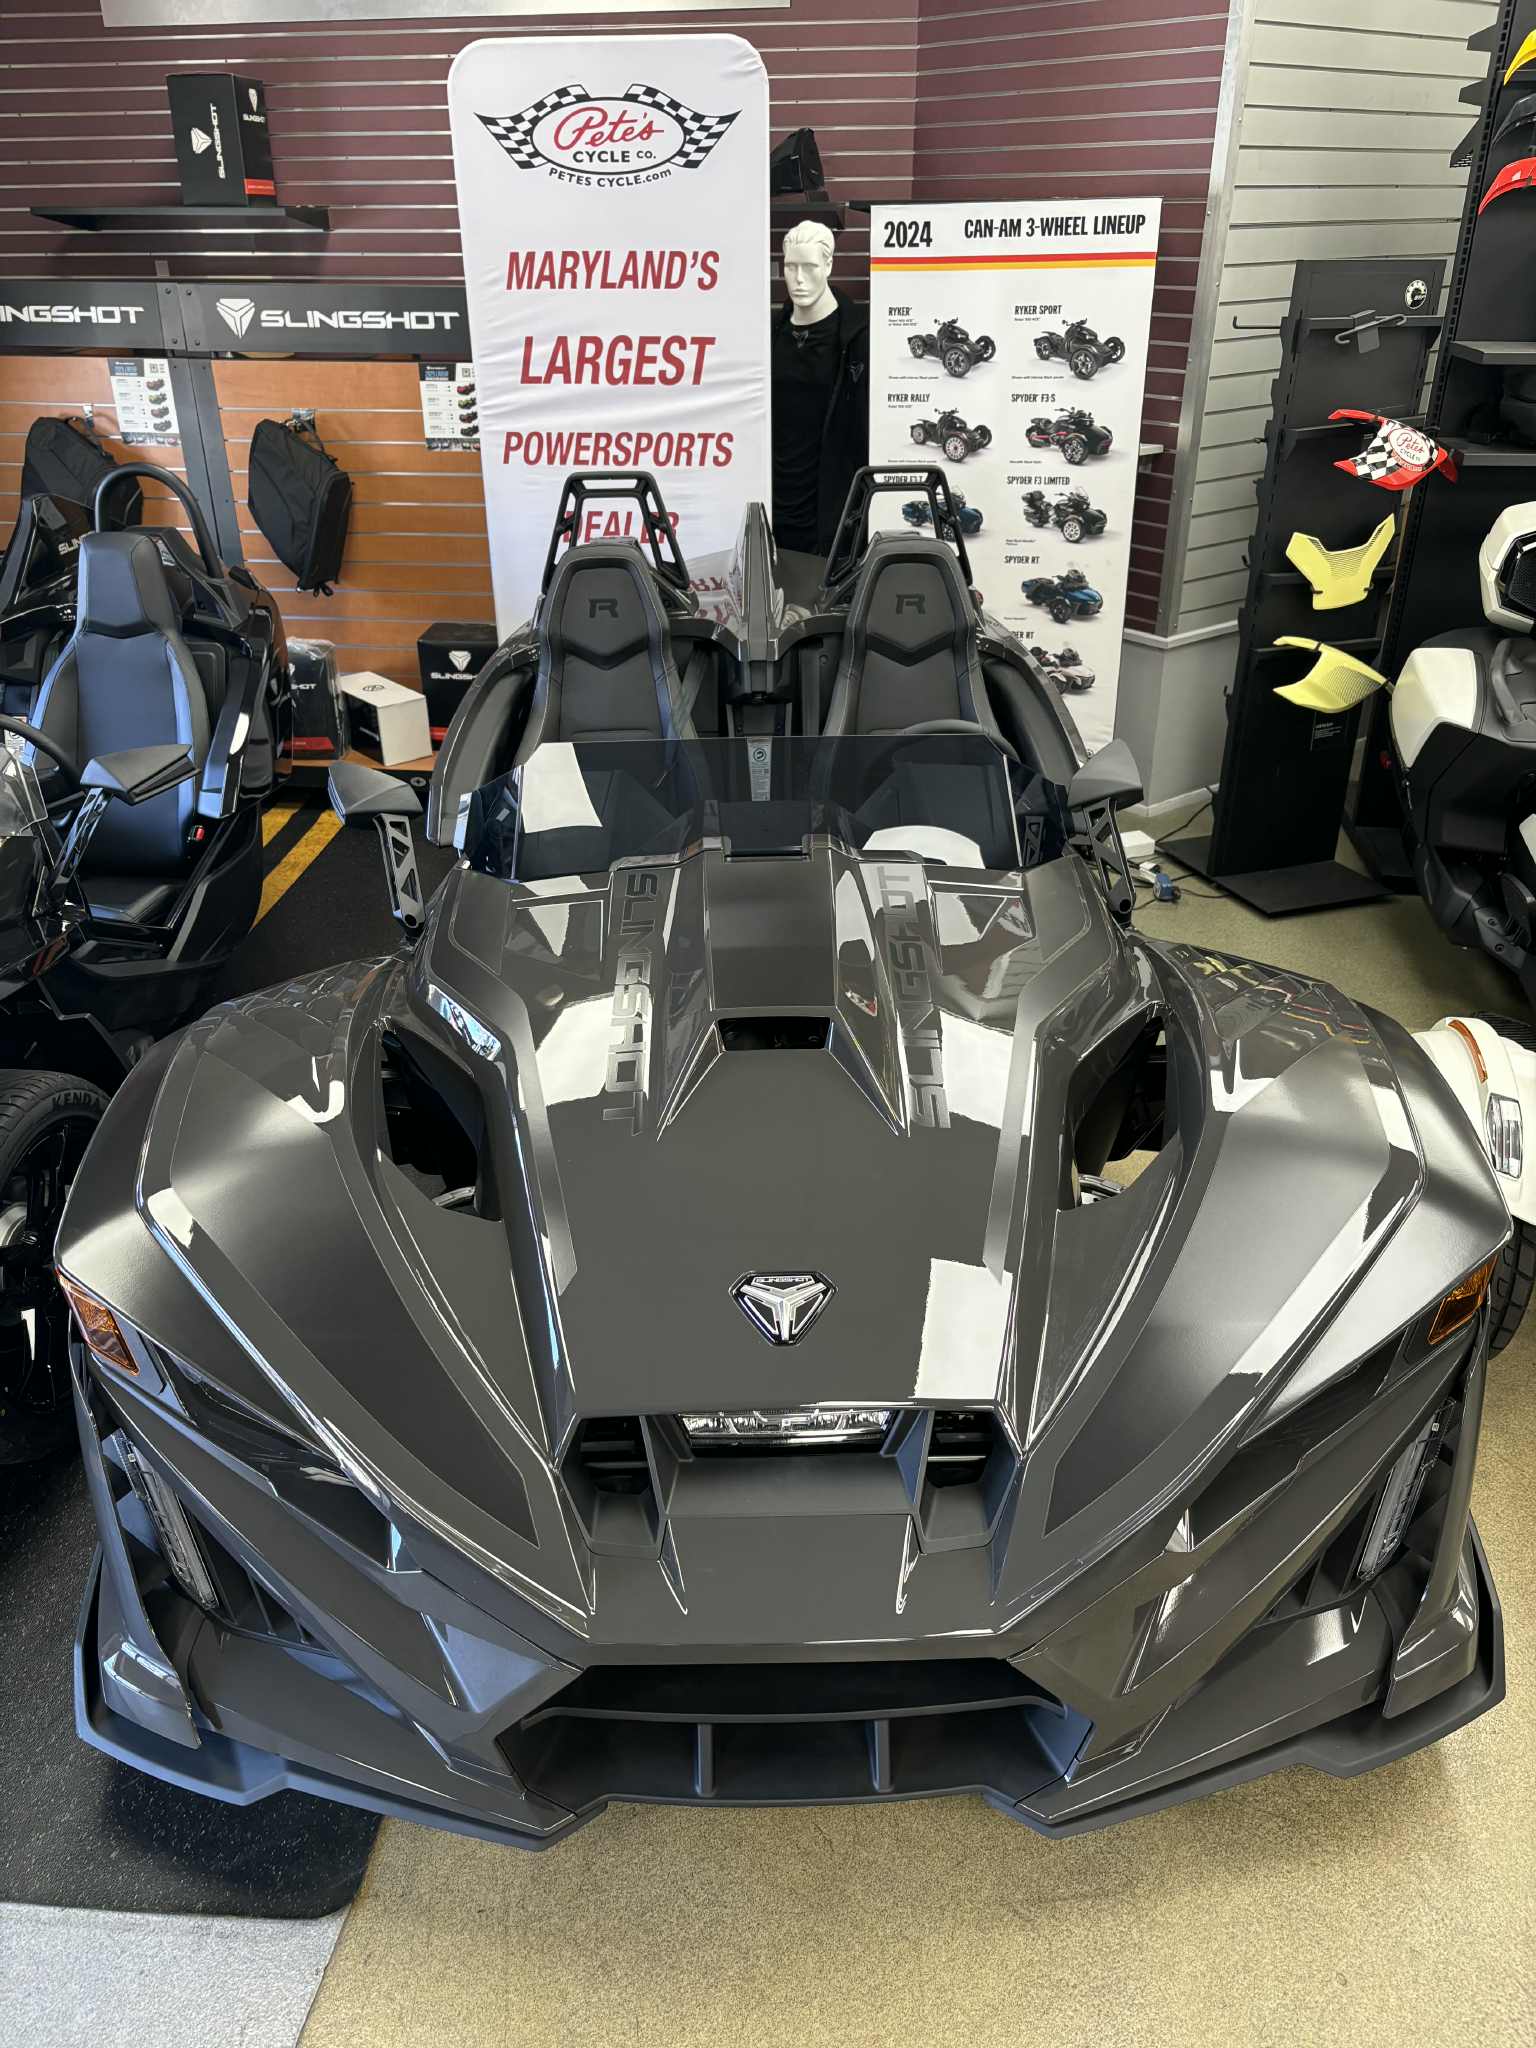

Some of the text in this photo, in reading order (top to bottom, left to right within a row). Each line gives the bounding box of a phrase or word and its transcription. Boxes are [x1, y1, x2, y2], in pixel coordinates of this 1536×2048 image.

[553, 106, 665, 151] Pete's
[210, 103, 226, 179] SLINGSHOT
[572, 150, 657, 163] CYCLE CO.
[549, 167, 672, 188] PETES CYCLE.com
[883, 214, 1146, 248] 2024 CAN-AM 3-WHEEL LINEUP
[506, 250, 720, 290] MARYLAND'S
[0, 305, 144, 324] INGSHOT
[260, 310, 460, 330] SLINGSHOT
[1014, 304, 1062, 315] RYKER SPORT
[520, 335, 716, 386] LARGEST
[888, 393, 931, 402] RYKER RALLY
[503, 431, 734, 467] POWERSPORTS
[1007, 475, 1071, 485] SPYDER F3 LIMITED
[1004, 555, 1040, 564] SPYDER RT
[896, 594, 925, 614] R
[603, 873, 658, 1136] SLINGSHOT
[877, 865, 951, 1129] SLINGSHOT
